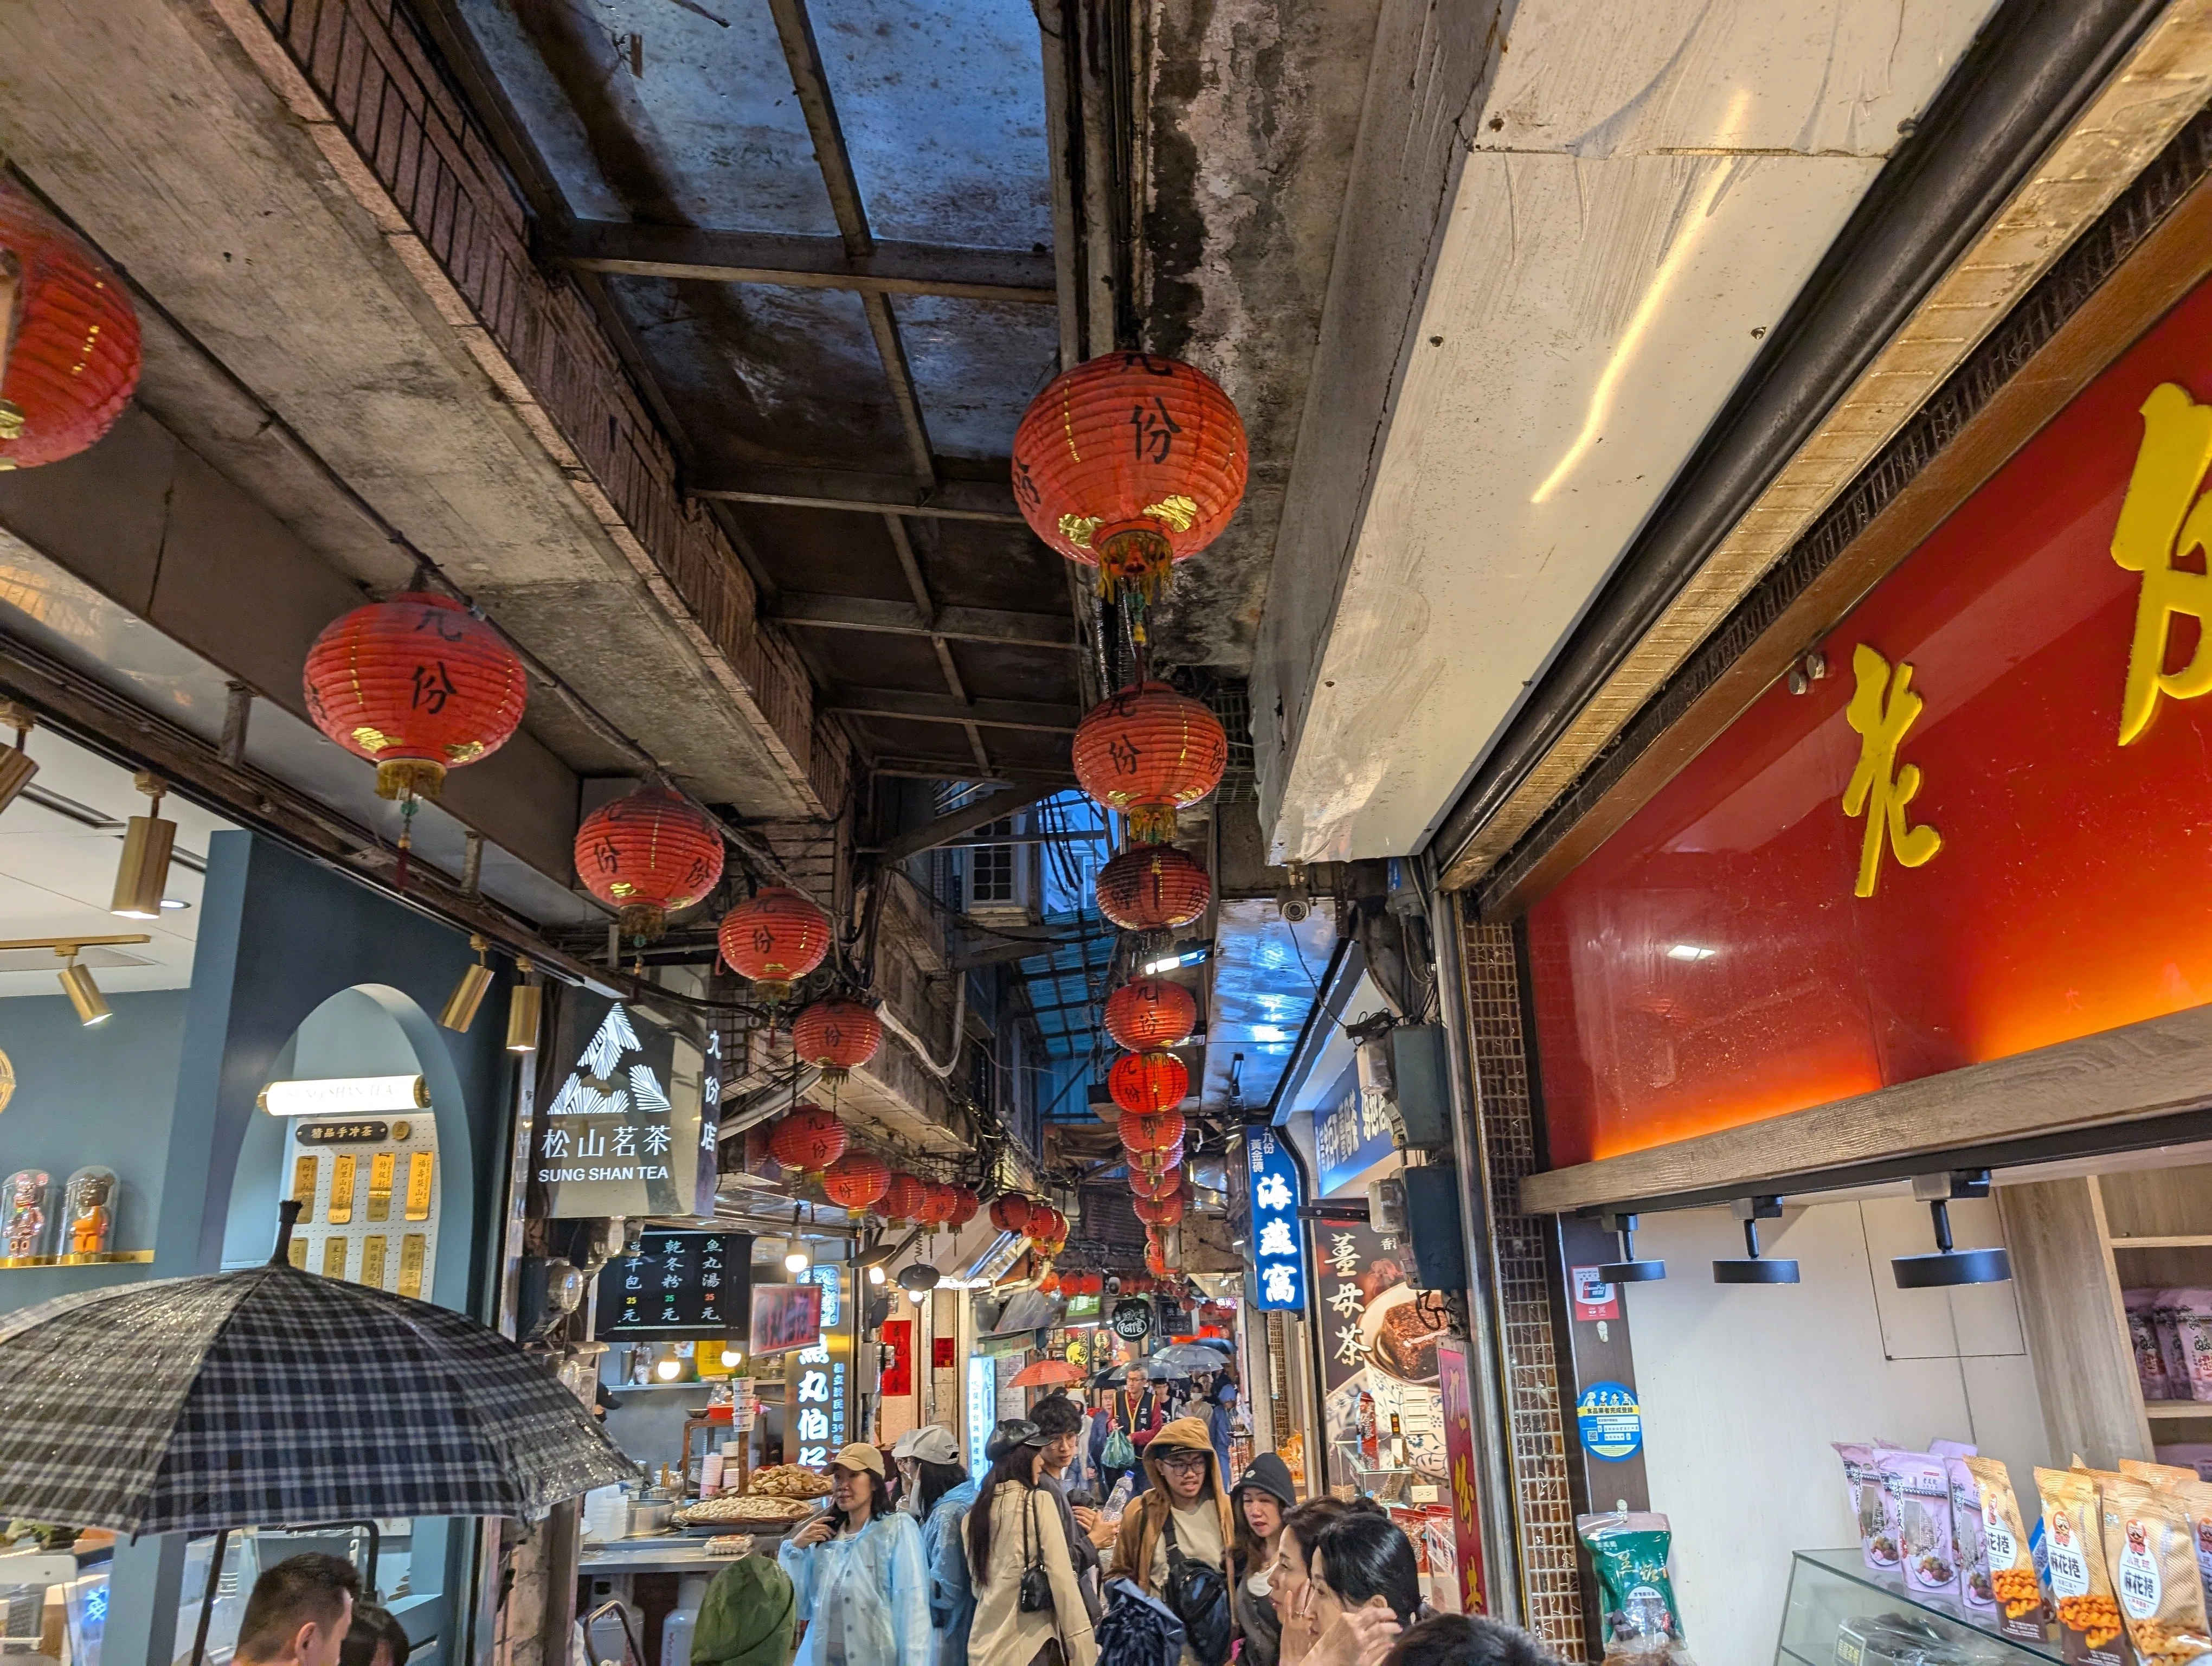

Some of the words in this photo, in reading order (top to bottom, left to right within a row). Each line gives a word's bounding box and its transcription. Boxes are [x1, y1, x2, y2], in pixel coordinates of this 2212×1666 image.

[410, 608, 464, 715] 九份
[1108, 693, 1141, 776] 九份
[700, 1029, 722, 1153] 九份店
[540, 1125, 672, 1158] 松山茗茶
[538, 1168, 585, 1182] SUNG
[588, 1167, 634, 1181] SHAN
[636, 1166, 668, 1179] TEA
[1257, 1173, 1297, 1304] 海燕窩
[1324, 1232, 1372, 1367] 薑母茶
[1586, 1406, 1634, 1414] 食品業者完成登錄
[2050, 1550, 2081, 1579] 麻花捲
[2124, 1570, 2155, 1599] 麻花捲
